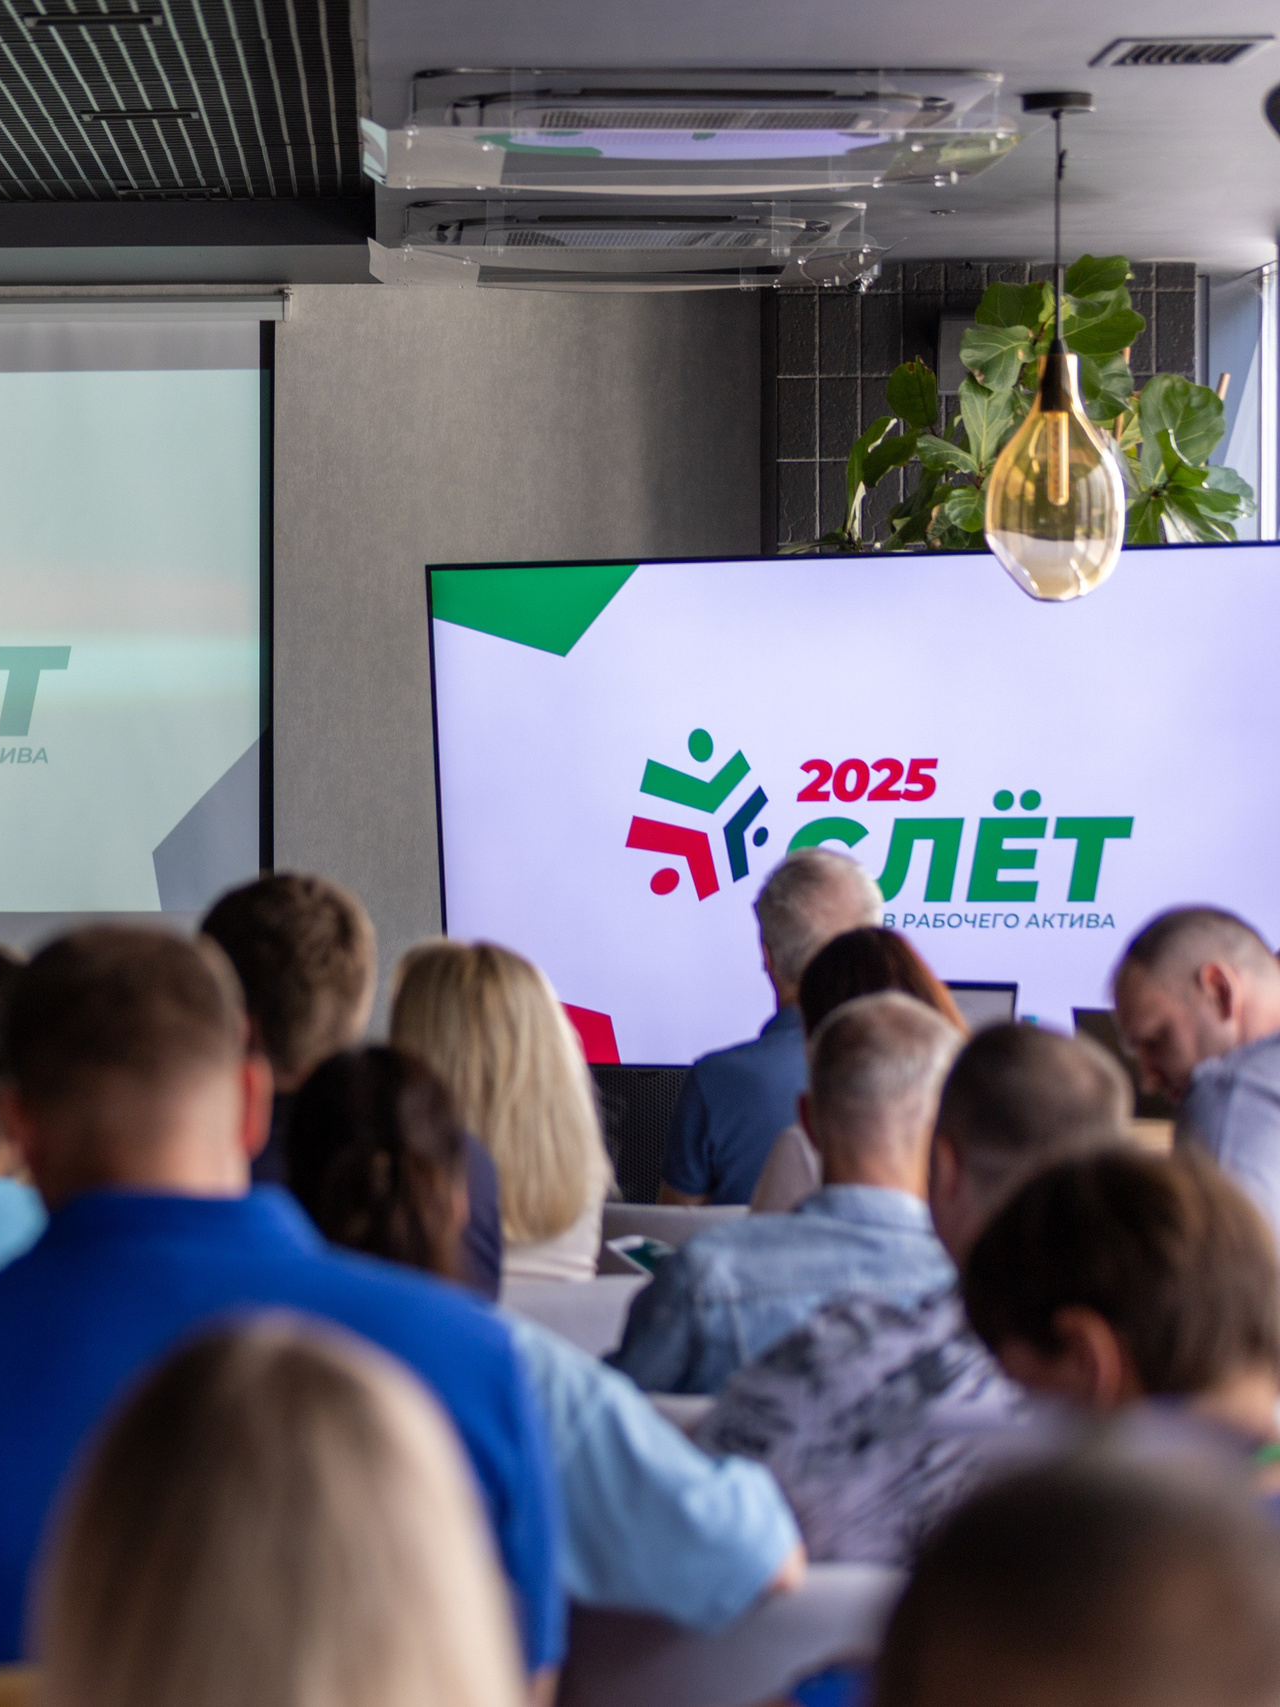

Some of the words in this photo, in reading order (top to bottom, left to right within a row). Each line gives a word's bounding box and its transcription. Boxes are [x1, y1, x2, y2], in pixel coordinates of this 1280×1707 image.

[796, 758, 939, 802] 2025
[902, 913, 1020, 929] РАБОЧЕГО
[1025, 913, 1116, 929] АКТИВА
